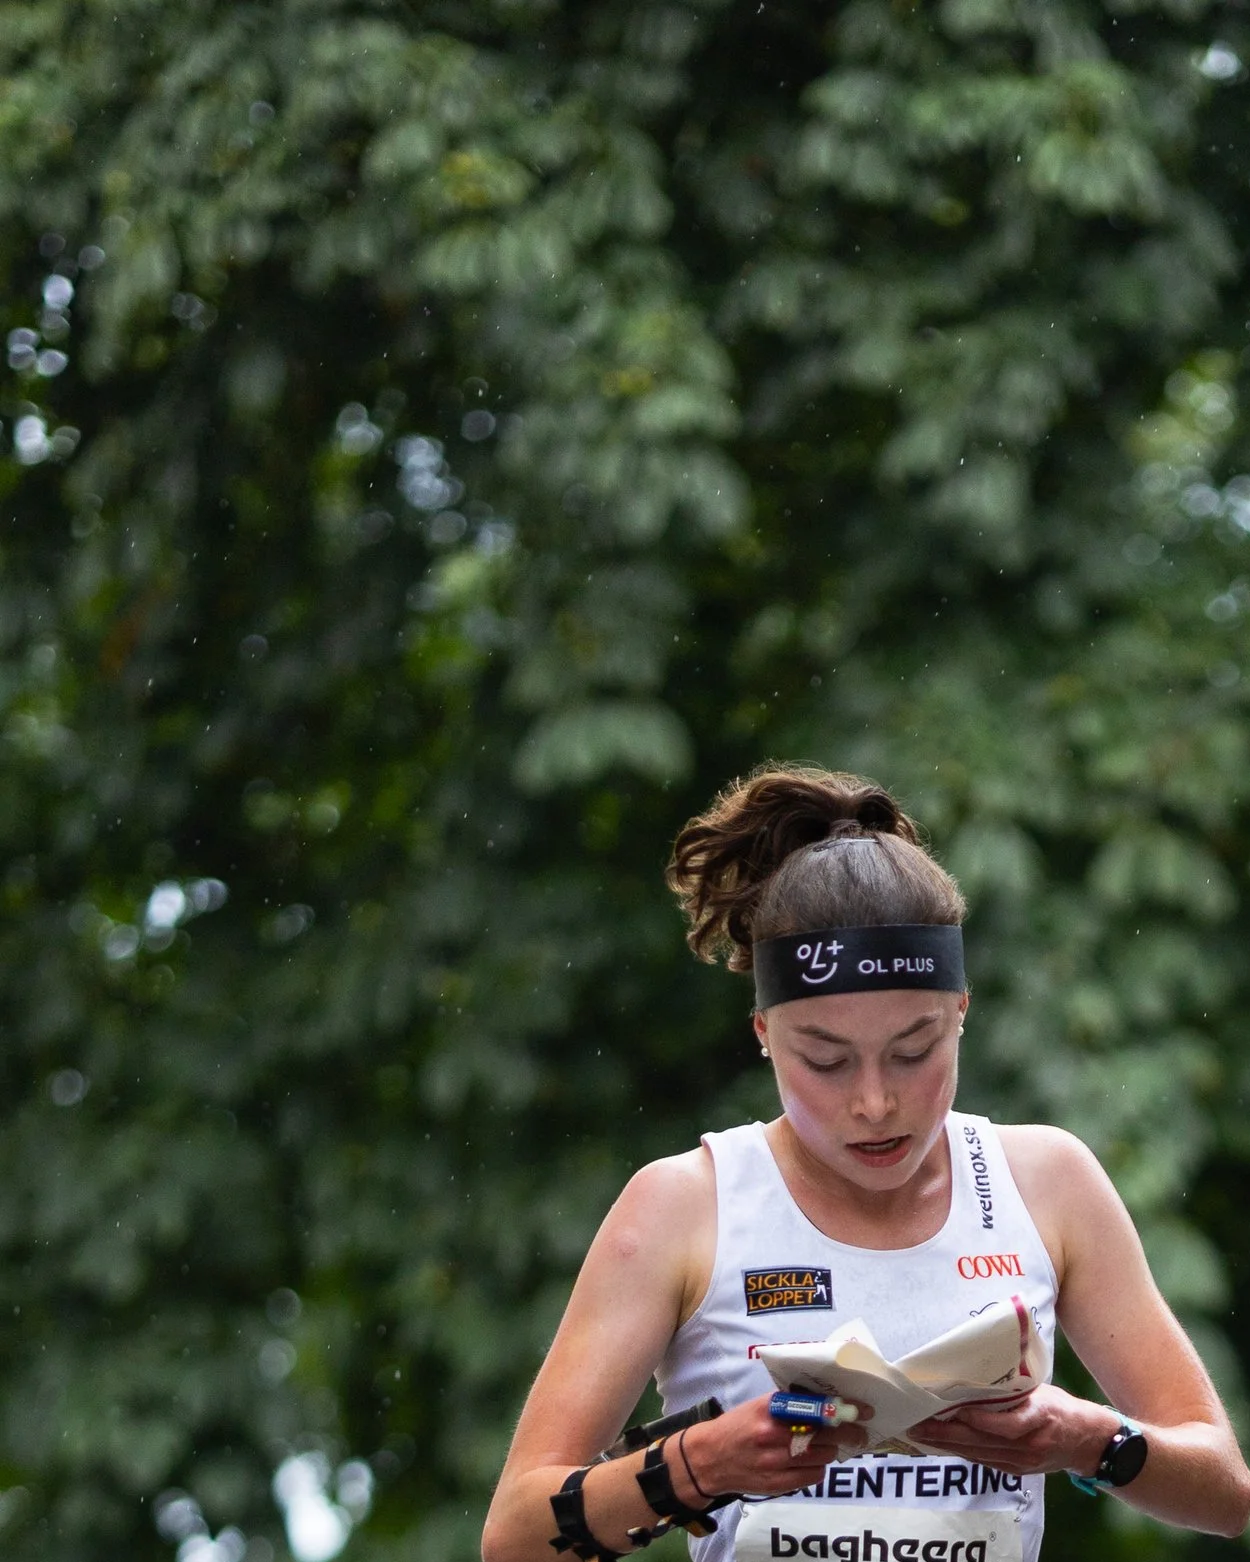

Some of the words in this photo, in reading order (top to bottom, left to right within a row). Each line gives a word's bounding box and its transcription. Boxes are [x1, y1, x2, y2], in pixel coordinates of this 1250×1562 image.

[858, 959, 888, 974] OL
[894, 957, 935, 973] PLUS
[957, 1254, 1026, 1280] COWI
[747, 1272, 814, 1292] SICKLA
[748, 1290, 816, 1310] LOPPET
